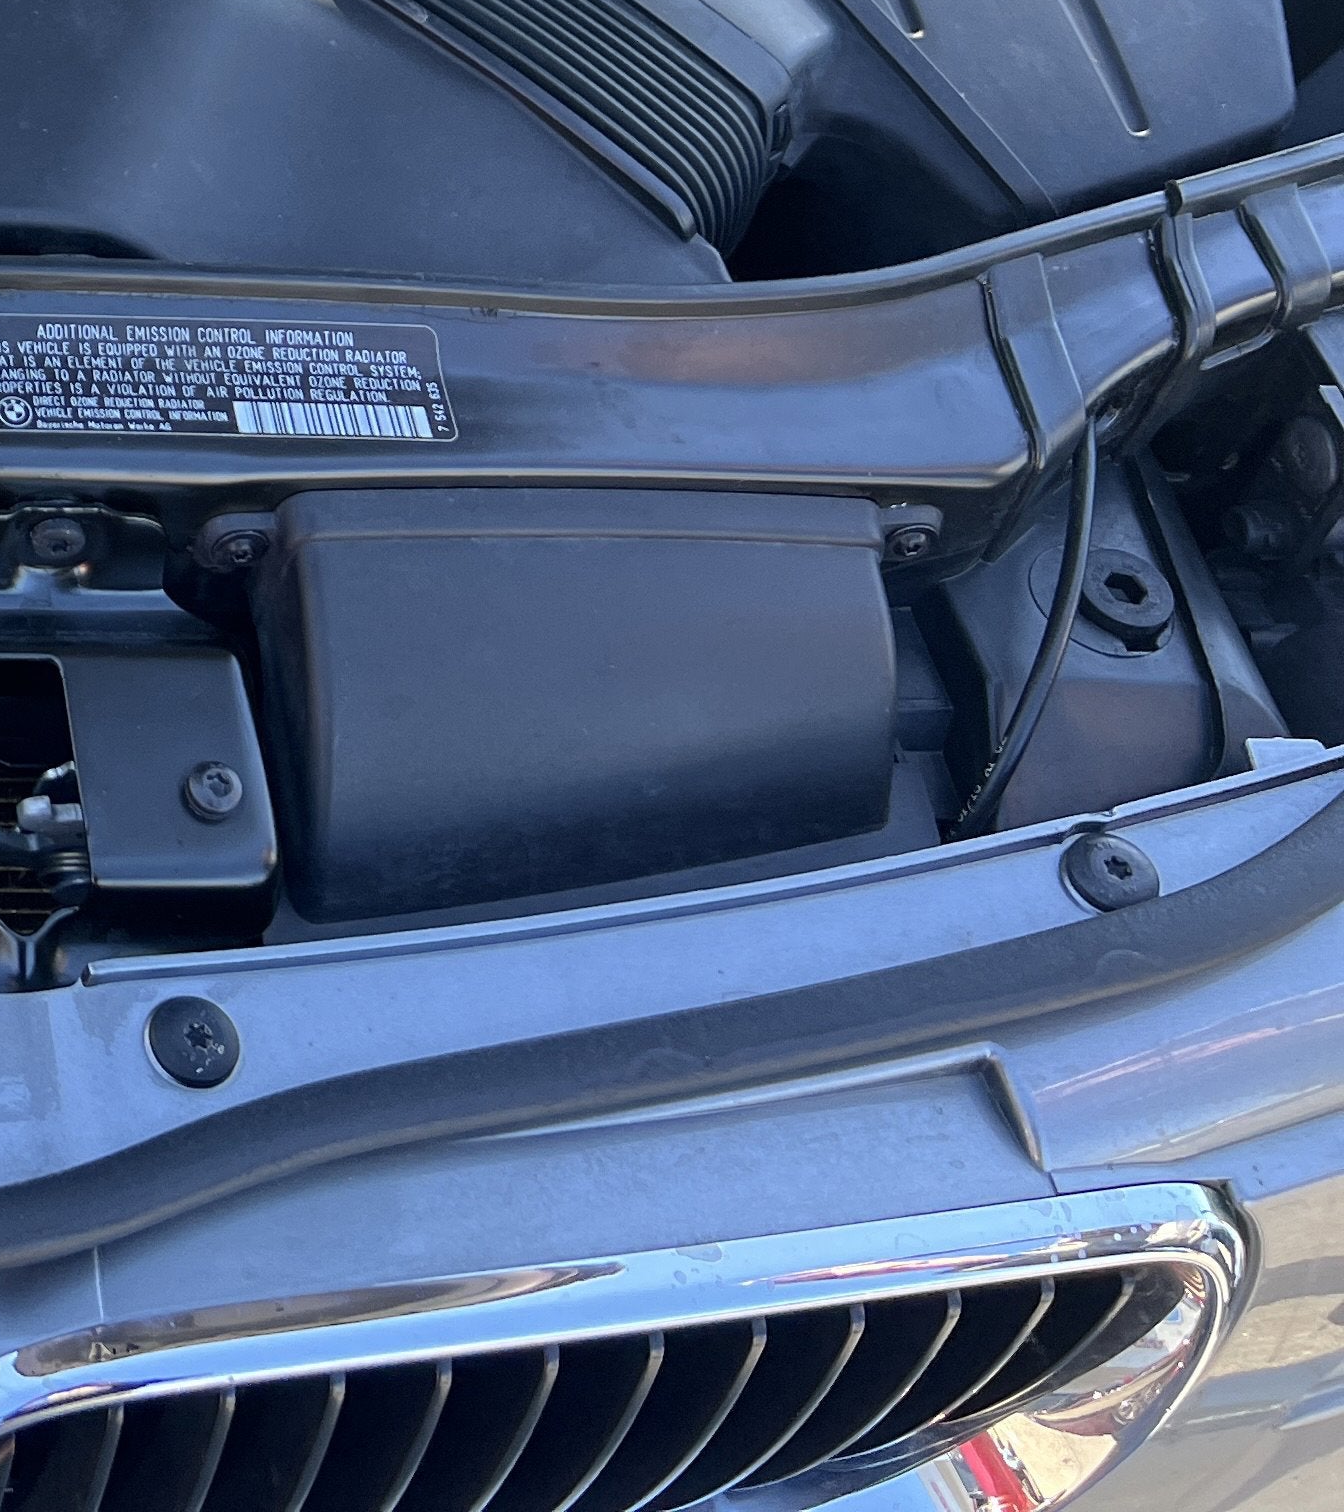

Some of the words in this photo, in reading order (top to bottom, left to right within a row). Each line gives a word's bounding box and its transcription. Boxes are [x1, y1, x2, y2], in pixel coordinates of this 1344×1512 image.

[37, 324, 118, 341] ADDITIONAL
[126, 325, 190, 342] EMISSION
[197, 327, 256, 344] CONTROL
[265, 329, 354, 347] INFORMATION
[17, 341, 70, 355] VEHICLE
[79, 342, 92, 355] IS
[98, 343, 158, 357] EQUIPPED
[164, 344, 197, 358] WITH
[203, 345, 221, 358] AN
[227, 346, 266, 360] OZONE
[273, 347, 339, 362] REDUCTION
[345, 349, 407, 364] RADIATOR
[23, 355, 36, 367] IS
[44, 356, 61, 368] AN
[67, 356, 123, 369] ELEMENT
[130, 358, 145, 370] OF
[154, 358, 176, 371] THE
[184, 359, 238, 372] VEHICLE
[244, 361, 303, 375] EMISSION
[309, 362, 363, 376] CONTROL
[54, 369, 70, 381] TO
[77, 370, 86, 381] A
[93, 370, 155, 383] RADIATOR
[162, 372, 216, 385] WITHOUT
[223, 373, 301, 387] EQUIVALENT
[309, 376, 347, 389] OZONE
[353, 378, 421, 391] REDUCTION
[32, 396, 65, 407] DIRECT
[70, 397, 98, 407] OZONE
[104, 397, 155, 408] REDUCTION
[158, 399, 205, 410] RADIATOR
[70, 382, 83, 394] IS
[91, 383, 100, 395] A
[107, 384, 176, 397] VIOLATION
[182, 385, 196, 397] OF
[206, 386, 229, 398] AIR
[234, 387, 304, 400] POLLUTION
[310, 389, 390, 403] REGULATION.
[34, 407, 72, 418] VEHICLE
[78, 409, 121, 419] EMISSION
[124, 410, 164, 420] CONTROL
[168, 411, 229, 422] INFORMATION
